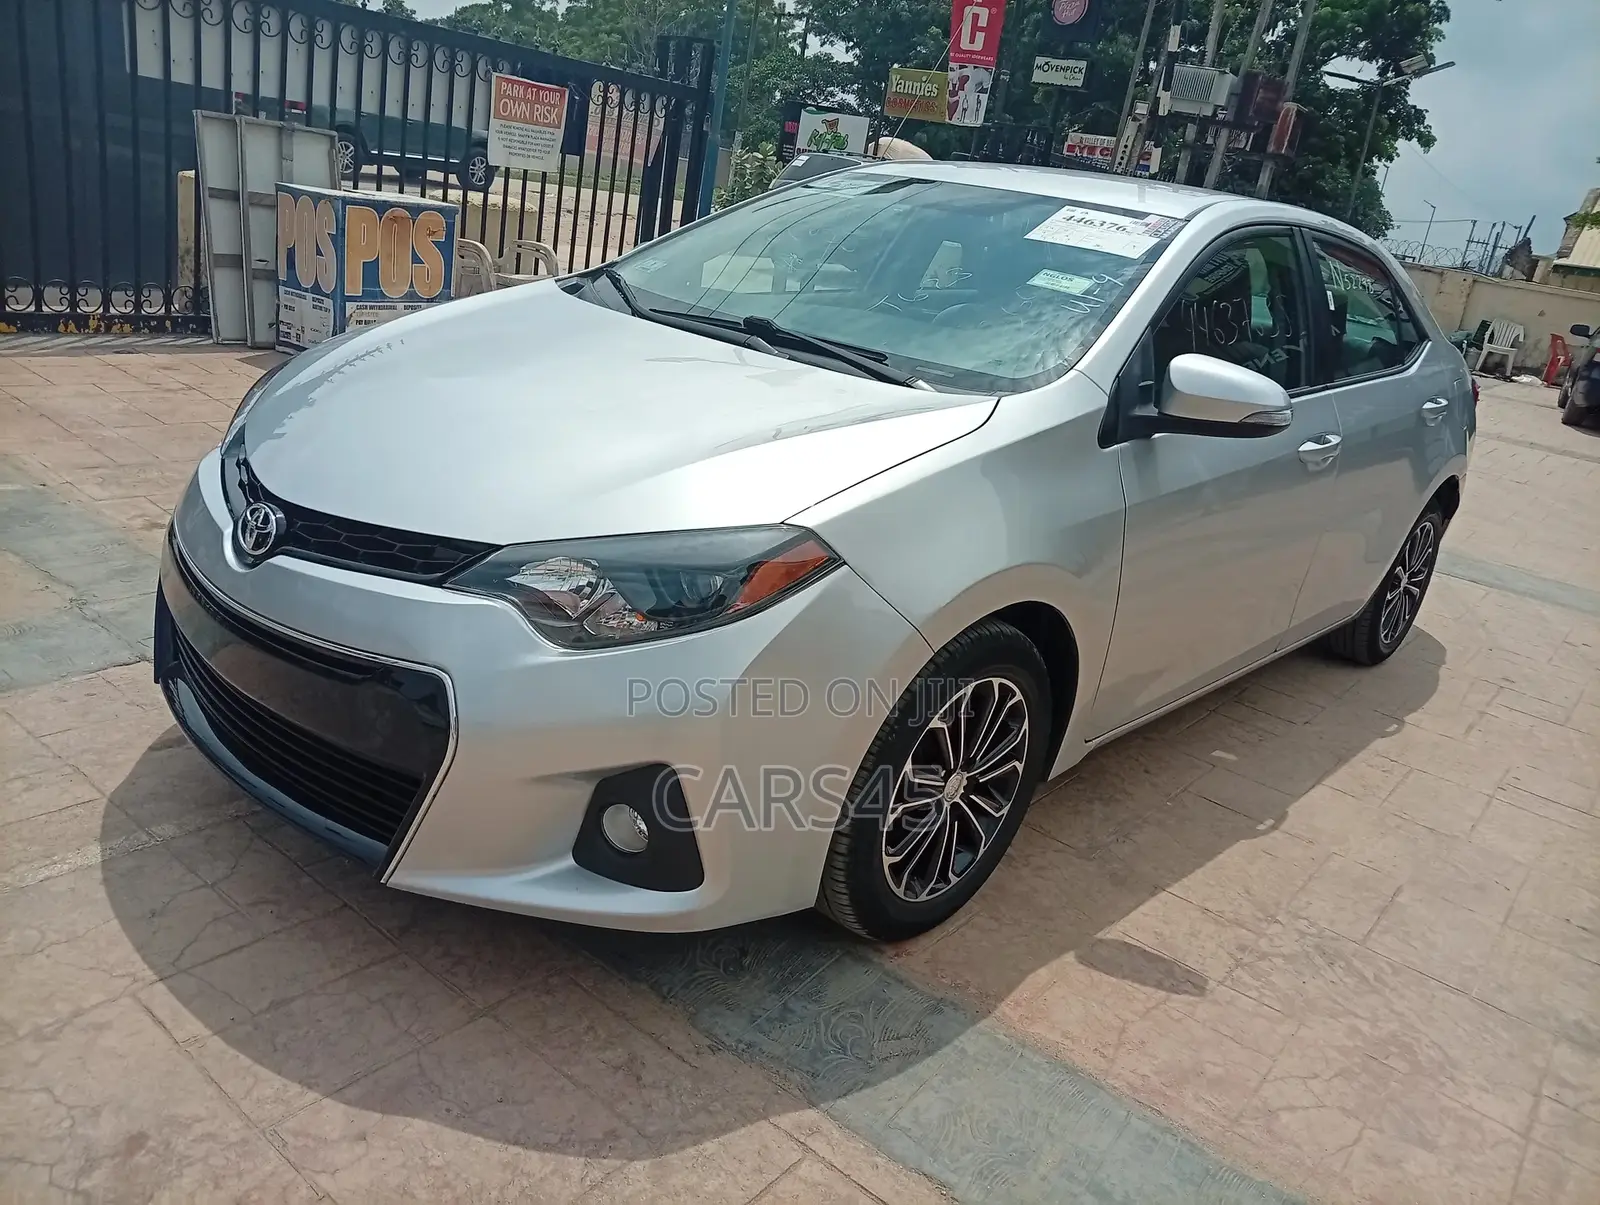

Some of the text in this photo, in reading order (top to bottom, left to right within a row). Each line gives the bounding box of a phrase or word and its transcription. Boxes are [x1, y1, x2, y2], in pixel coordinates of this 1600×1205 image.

[1059, 1, 1080, 12] Pizza
[1062, 8, 1077, 18] Hut
[501, 81, 561, 105] PARK AT YOUR
[891, 74, 939, 97] Yannies
[499, 98, 559, 125] OWN RISK
[885, 97, 937, 113] COSMETICS
[278, 191, 338, 294] POS
[345, 205, 447, 299] POS
